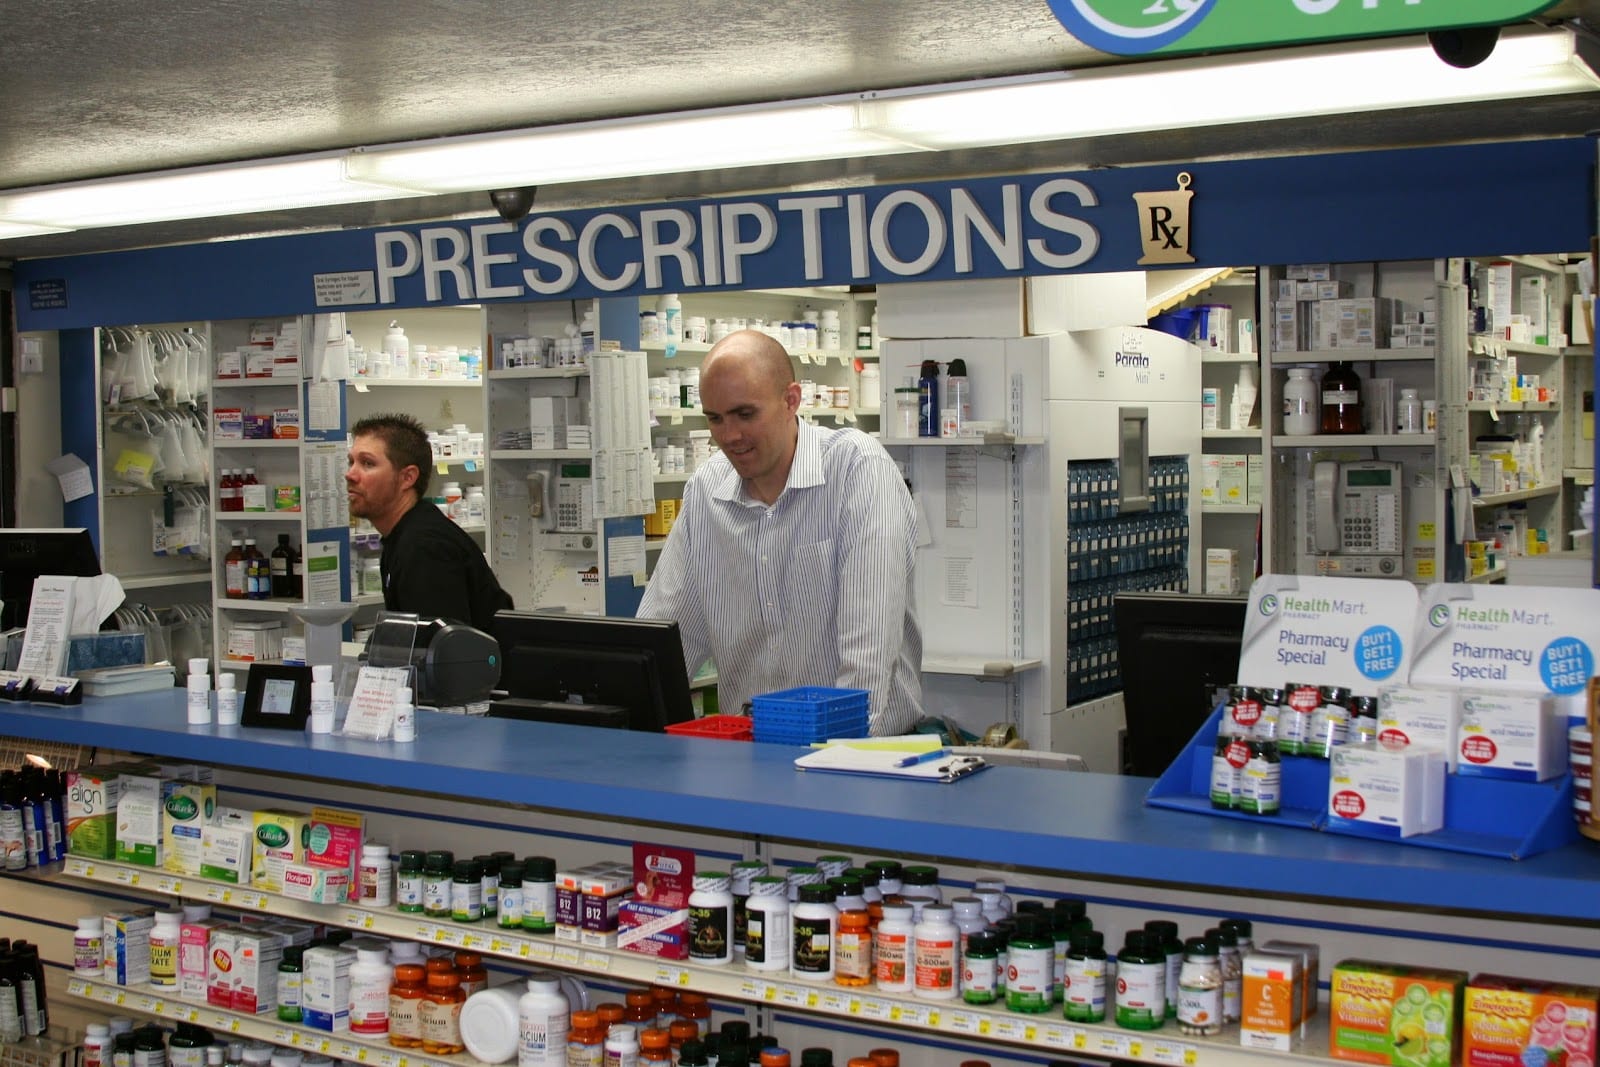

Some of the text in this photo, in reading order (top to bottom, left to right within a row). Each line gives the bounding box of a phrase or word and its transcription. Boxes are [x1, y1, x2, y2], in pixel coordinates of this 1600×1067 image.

[374, 177, 1101, 305] PRESCRIPTIONS
[1115, 351, 1149, 368] Parata
[1279, 629, 1350, 652] Pharmacy
[1276, 648, 1326, 666] Special
[1452, 642, 1533, 666] Pharmacy
[1364, 657, 1395, 673] FREE
[1451, 662, 1507, 680] Special
[1550, 671, 1586, 689] FREE
[71, 784, 102, 814] align
[1262, 984, 1272, 1001] C
[1338, 1011, 1378, 1024] Vitamin
[1471, 1031, 1515, 1045] Vitamin
